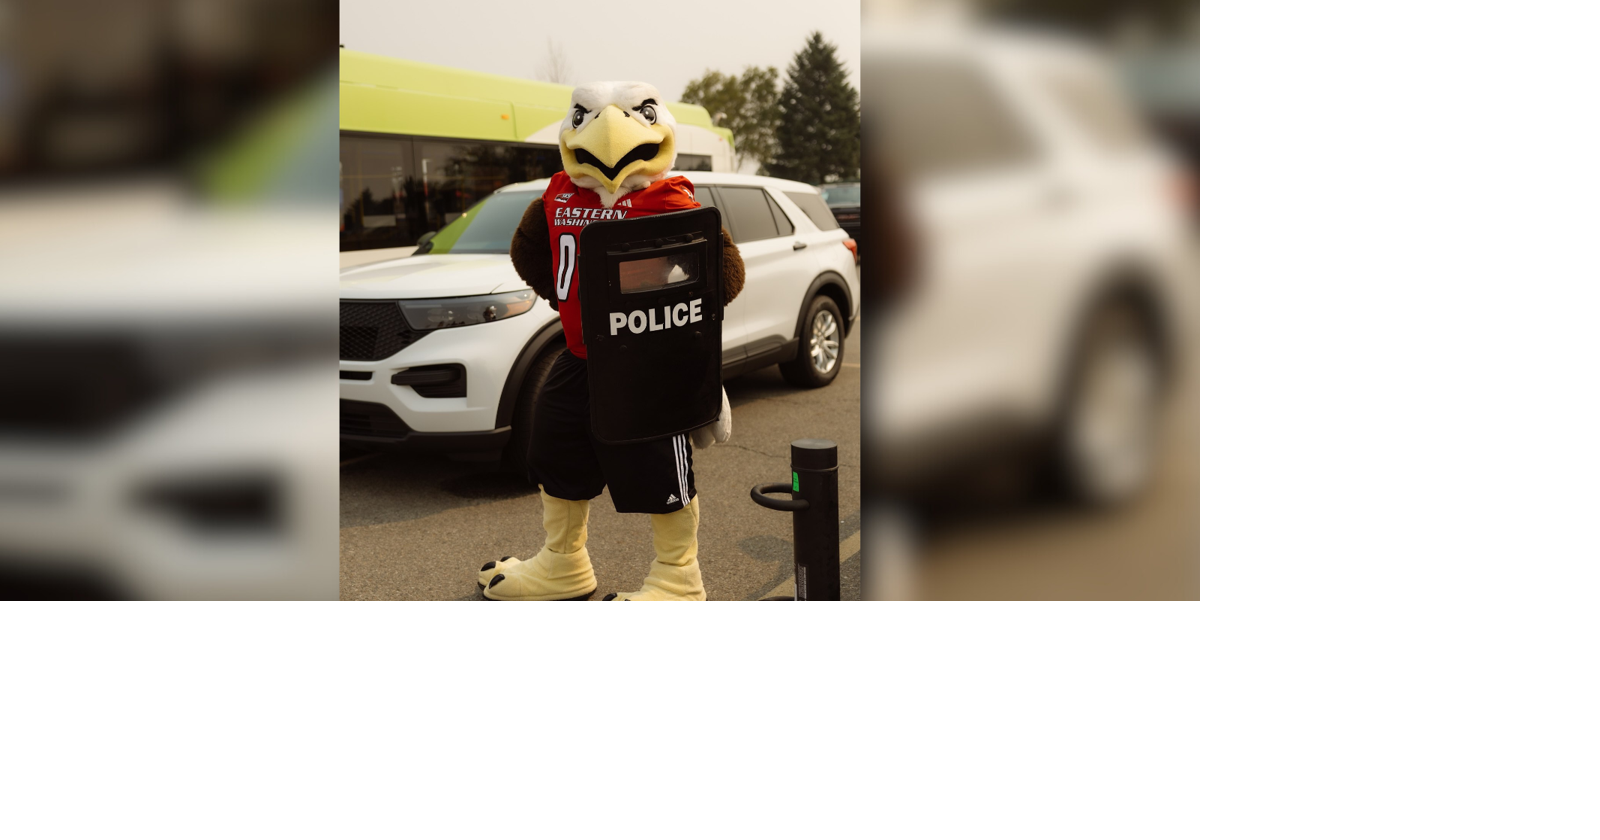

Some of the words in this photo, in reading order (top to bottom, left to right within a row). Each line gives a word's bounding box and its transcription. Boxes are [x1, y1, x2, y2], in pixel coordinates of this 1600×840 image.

[554, 218, 597, 227] WASHIN
[555, 207, 628, 220] EASTERN
[556, 233, 577, 302] 0
[609, 298, 703, 336] POLICE
